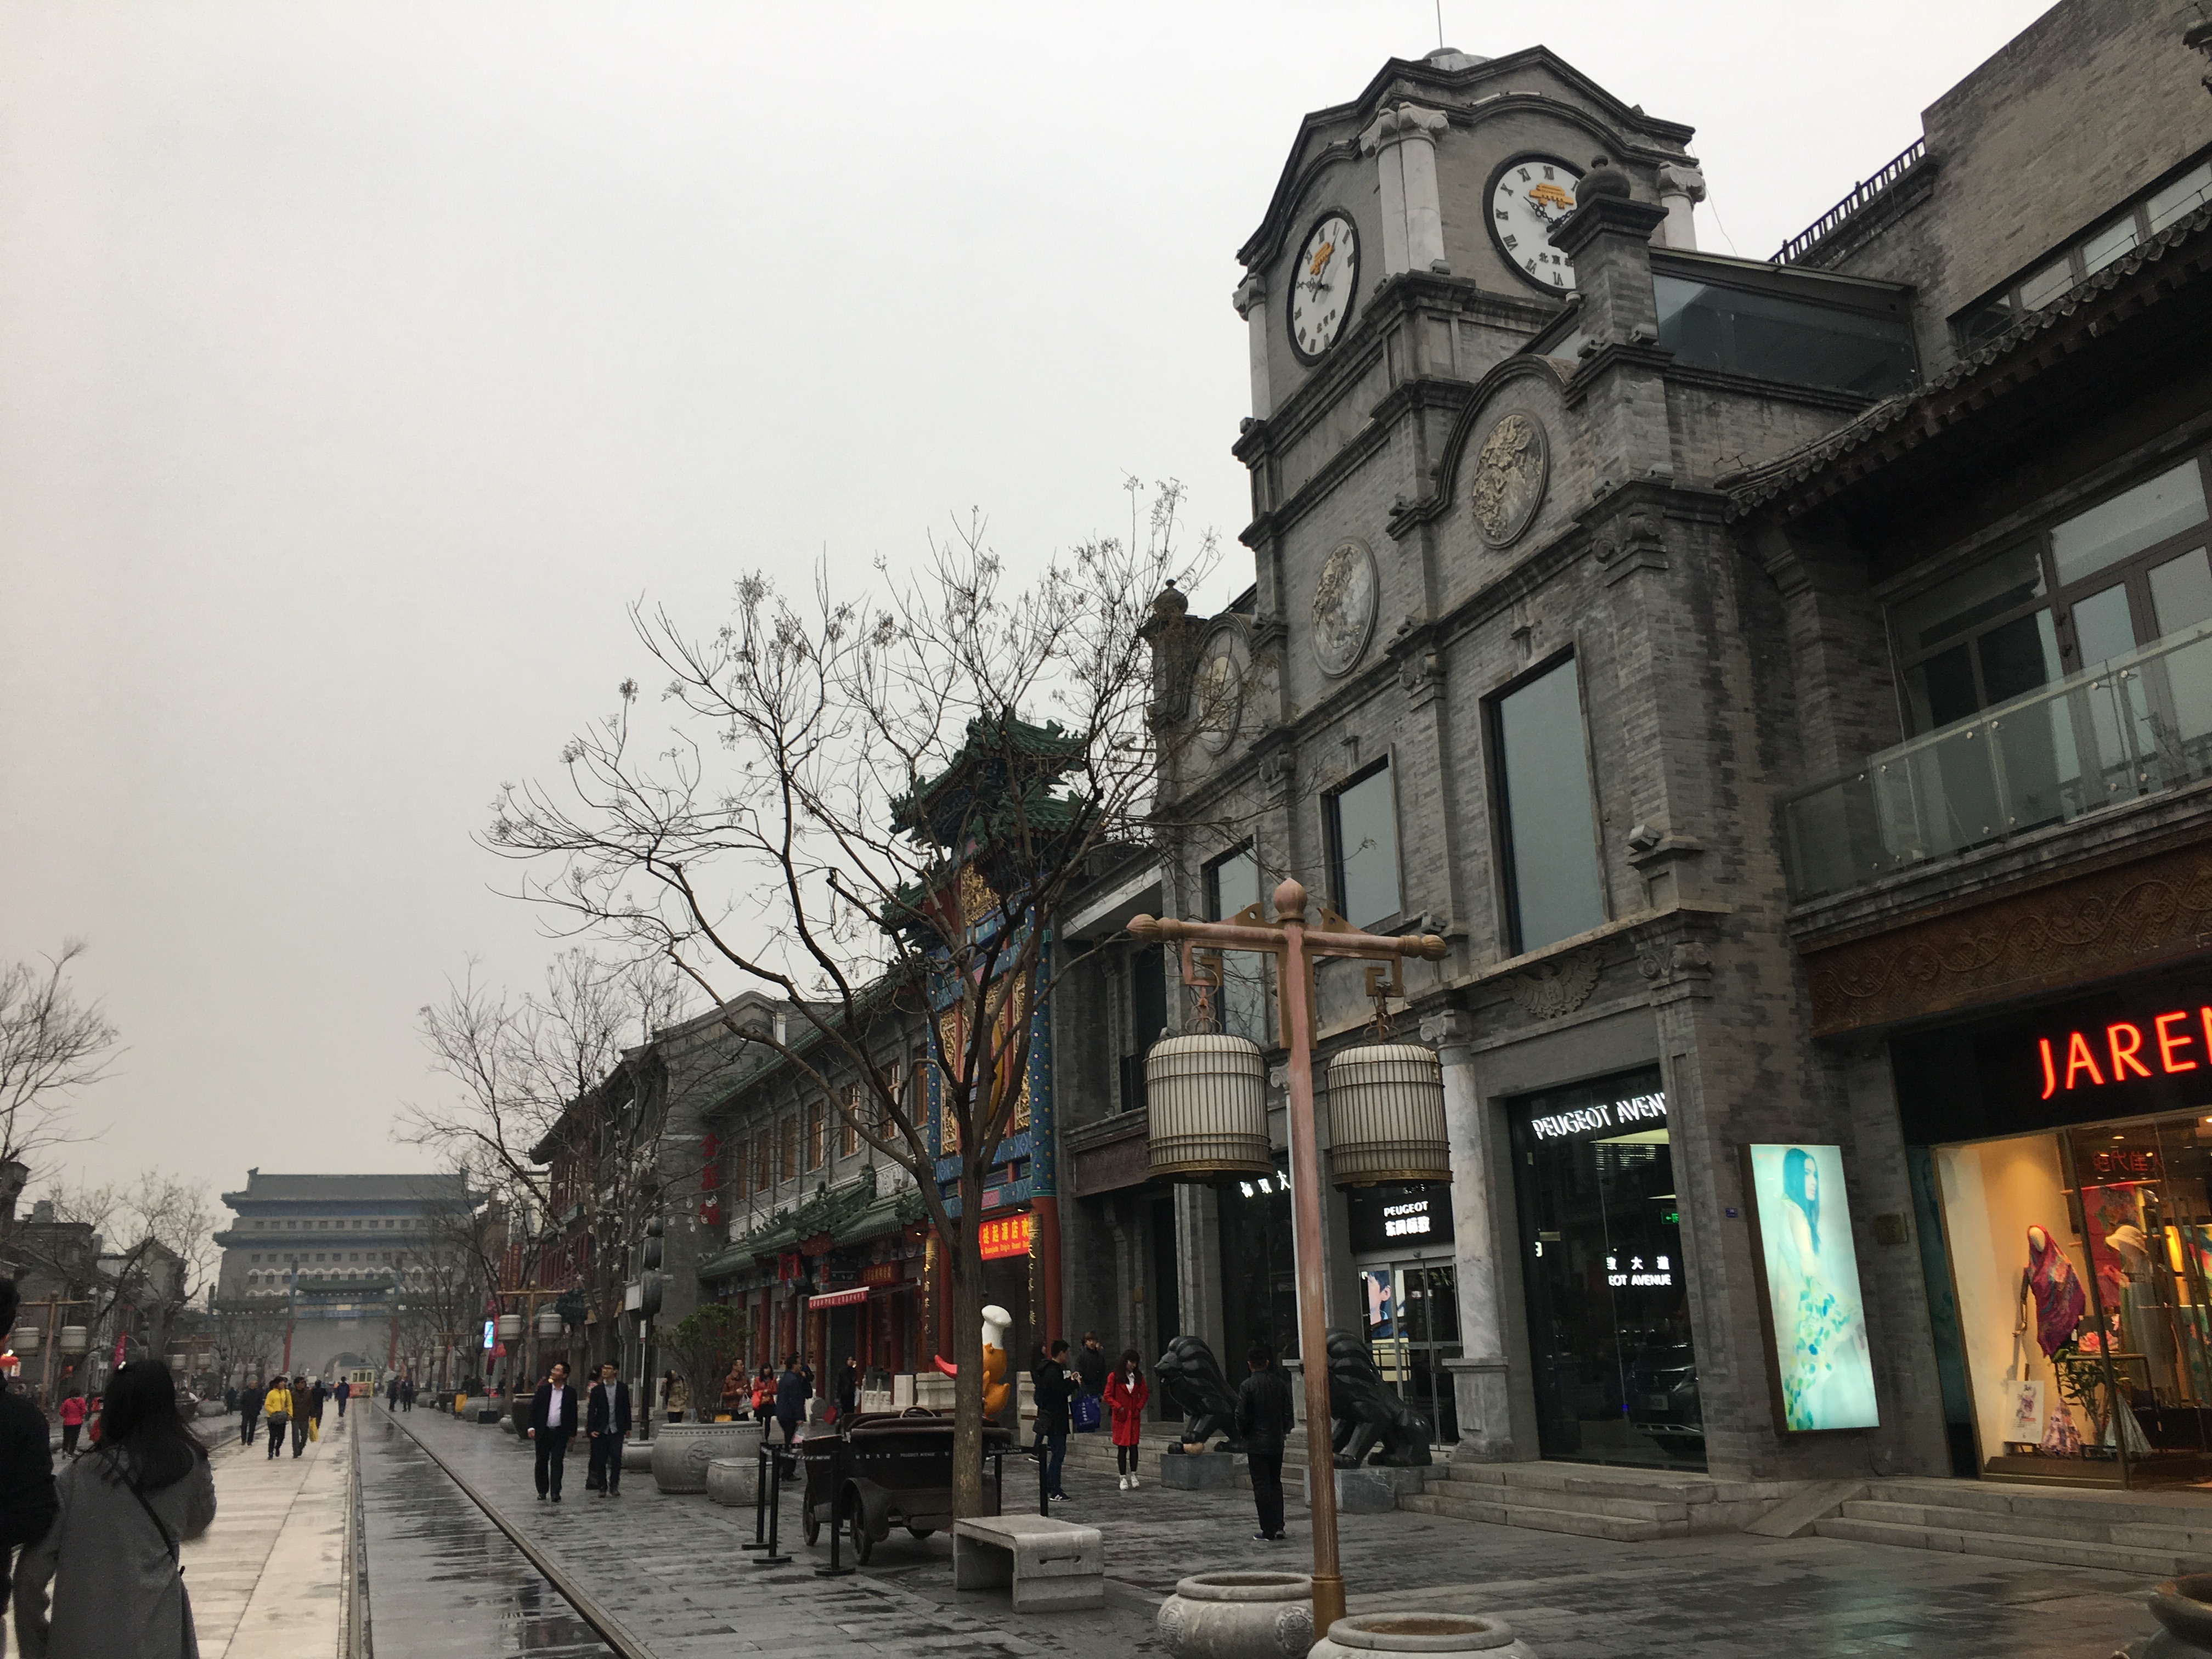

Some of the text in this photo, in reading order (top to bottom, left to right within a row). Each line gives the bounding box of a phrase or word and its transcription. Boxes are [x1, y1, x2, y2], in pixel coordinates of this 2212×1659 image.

[1531, 1092, 1667, 1140] PEUGEOT AVEN
[1384, 1201, 1428, 1217] PEUGEOT
[979, 1218, 1029, 1245] 德起源店欢
[1631, 1274, 1672, 1285] AVENUE
